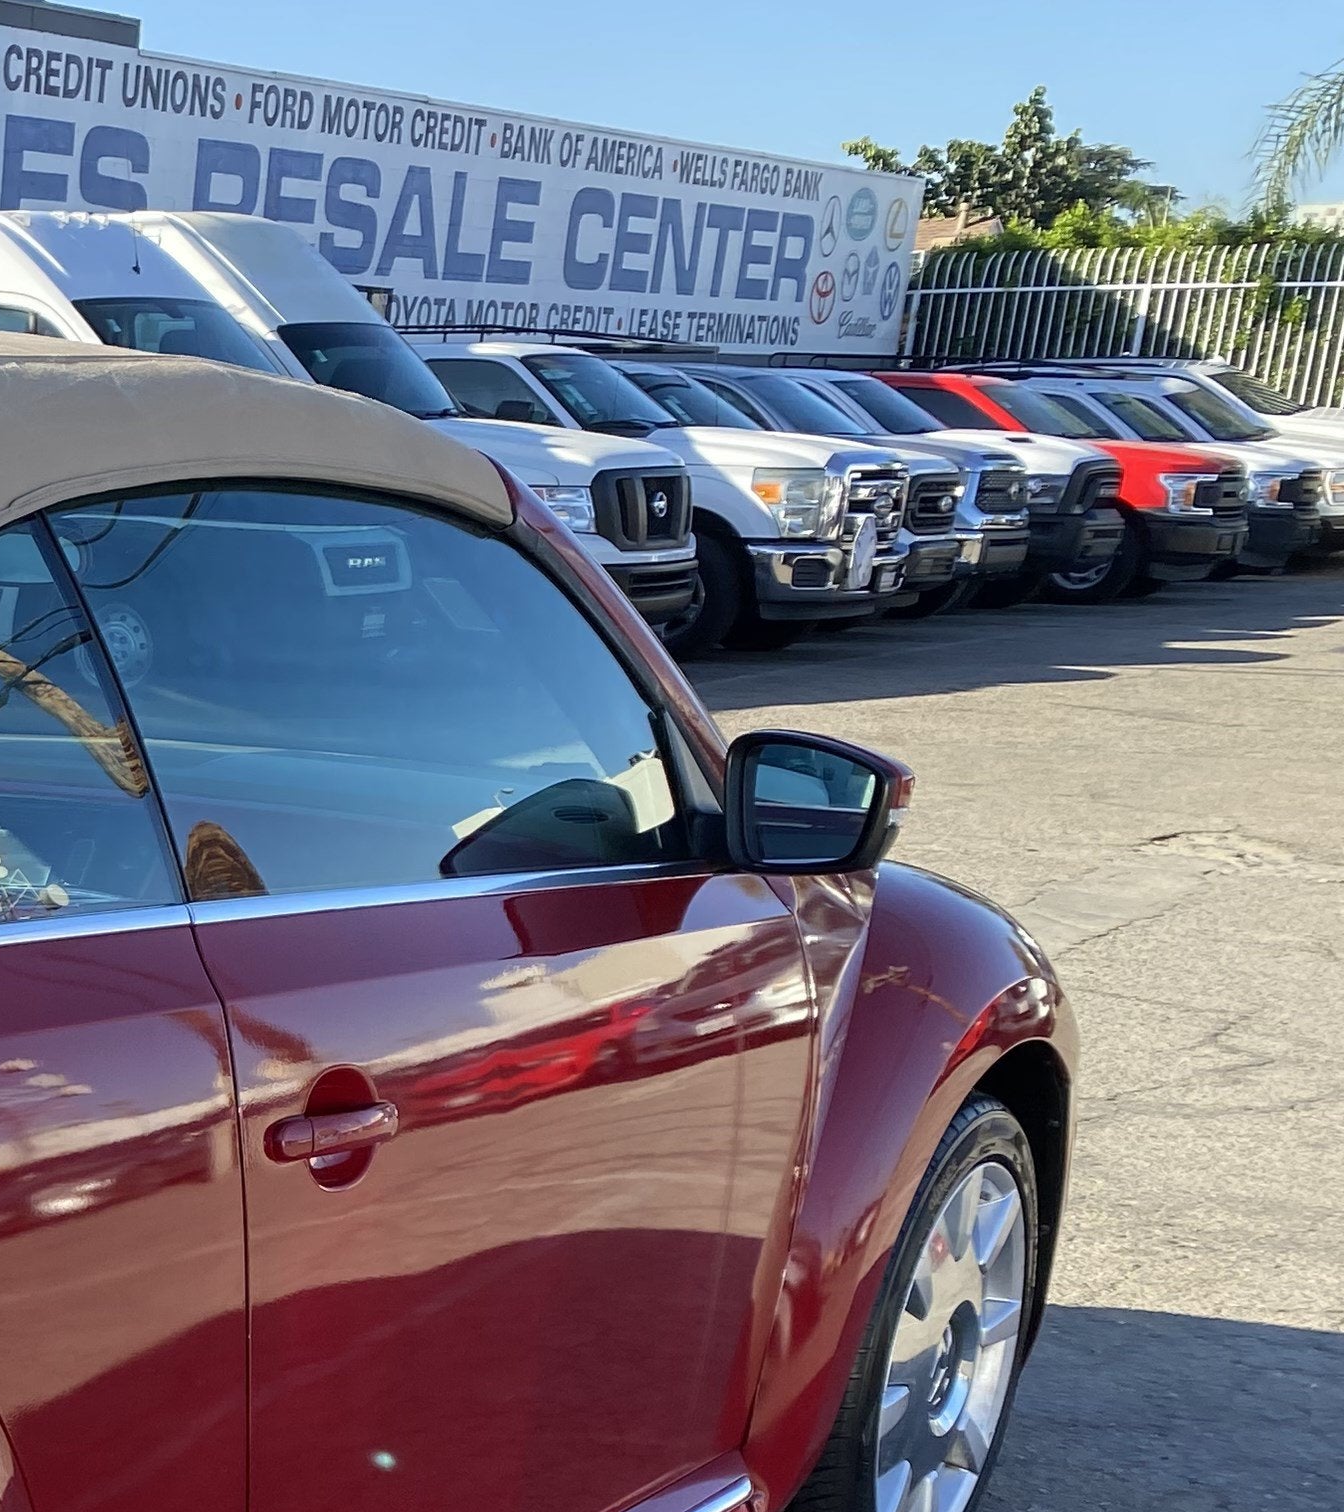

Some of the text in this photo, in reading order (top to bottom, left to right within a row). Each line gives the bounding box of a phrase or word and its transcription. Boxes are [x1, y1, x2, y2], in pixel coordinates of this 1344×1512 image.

[2, 44, 111, 103] CREDIT
[121, 63, 227, 120] UNIONS
[248, 83, 314, 131] FORD
[322, 94, 405, 146] MOTOR
[410, 108, 488, 157] CREDIT
[499, 122, 554, 166] BANK
[559, 131, 583, 170] OF
[585, 136, 664, 181] AMERICA
[679, 152, 729, 189] WELLS
[730, 160, 780, 197] FARGO
[782, 167, 823, 201] BANK
[562, 186, 814, 303] CENTER
[465, 298, 541, 335] MOTOR
[546, 302, 614, 335] CREDIT
[628, 307, 682, 338] LEASE
[686, 310, 800, 346] TERMINATIONS
